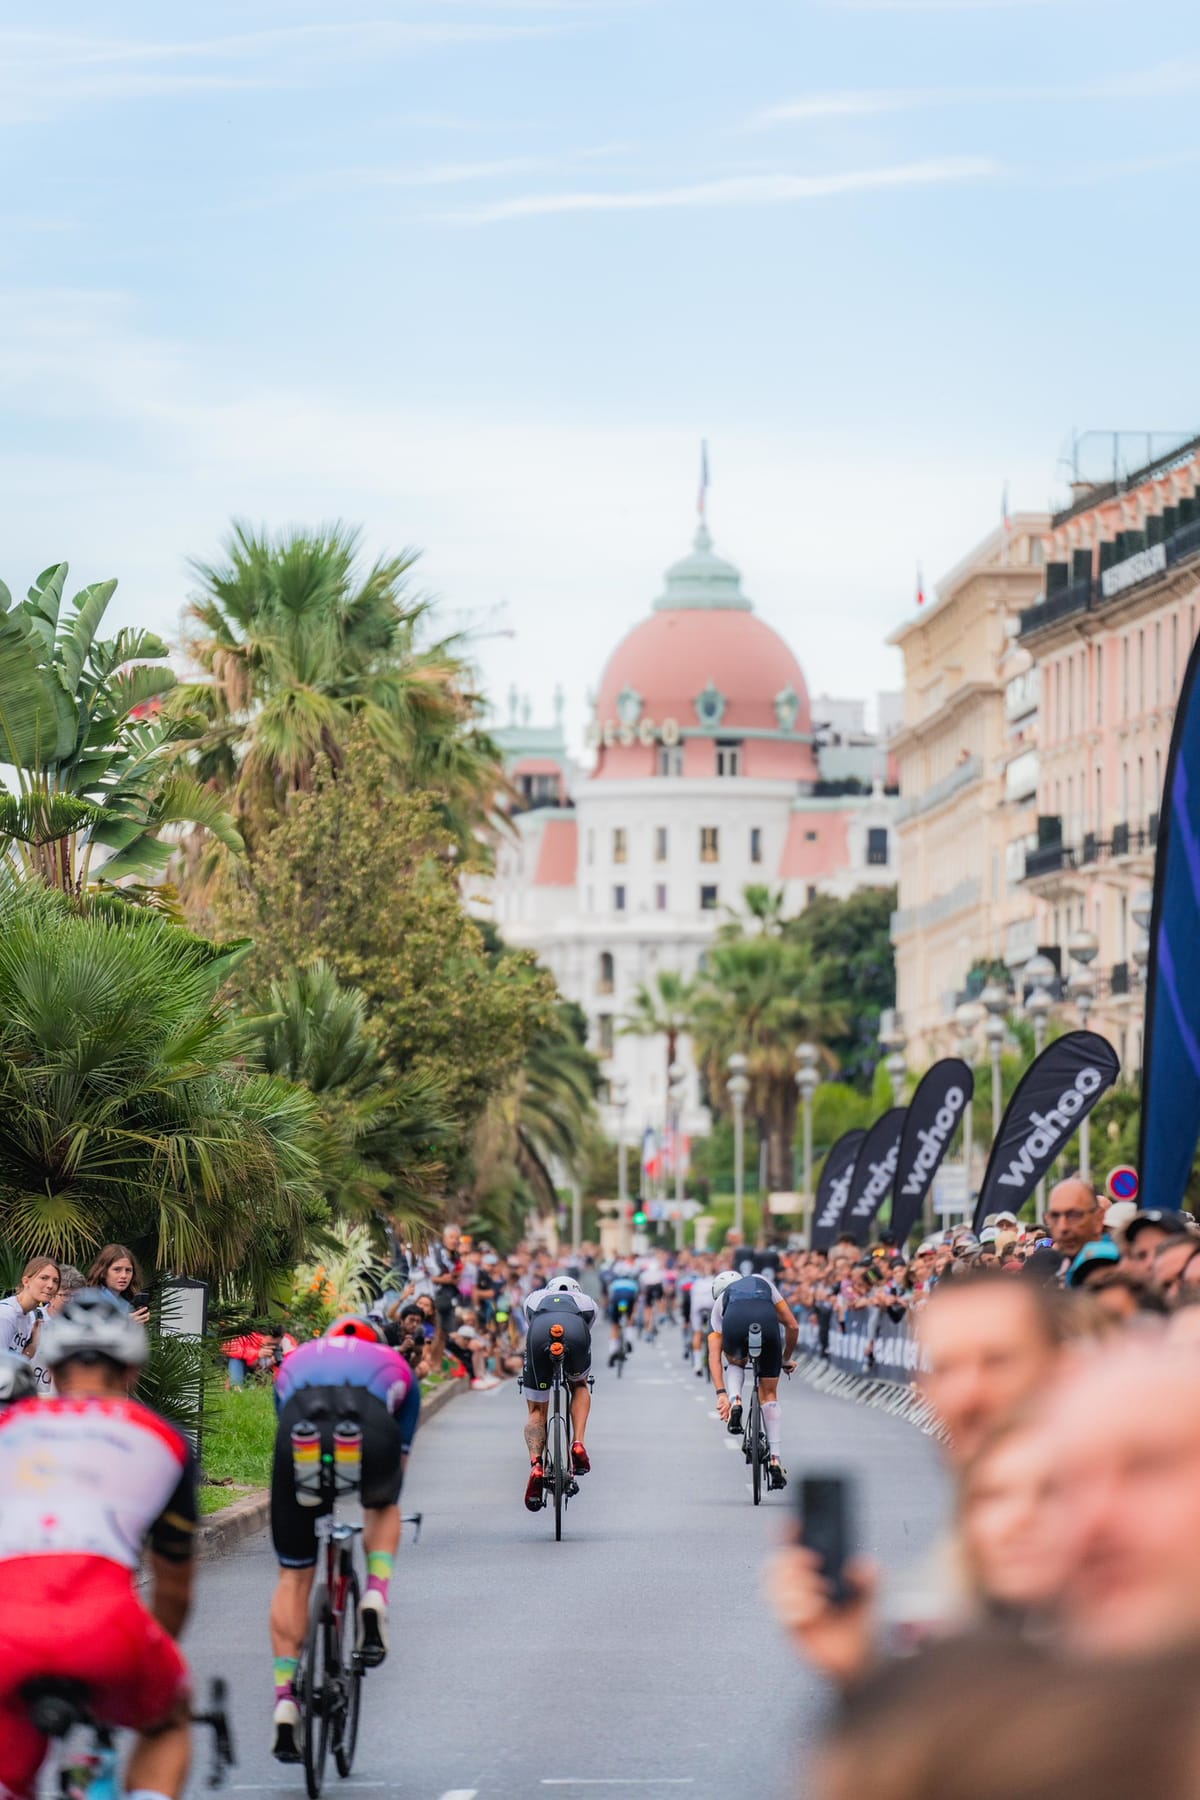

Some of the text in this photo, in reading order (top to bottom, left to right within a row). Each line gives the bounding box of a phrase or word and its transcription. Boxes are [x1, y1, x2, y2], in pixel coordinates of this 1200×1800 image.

[901, 1086, 964, 1195] wahoo
[998, 1067, 1102, 1187] wahoo
[817, 1163, 855, 1228] wah
[851, 1136, 899, 1216] waho
